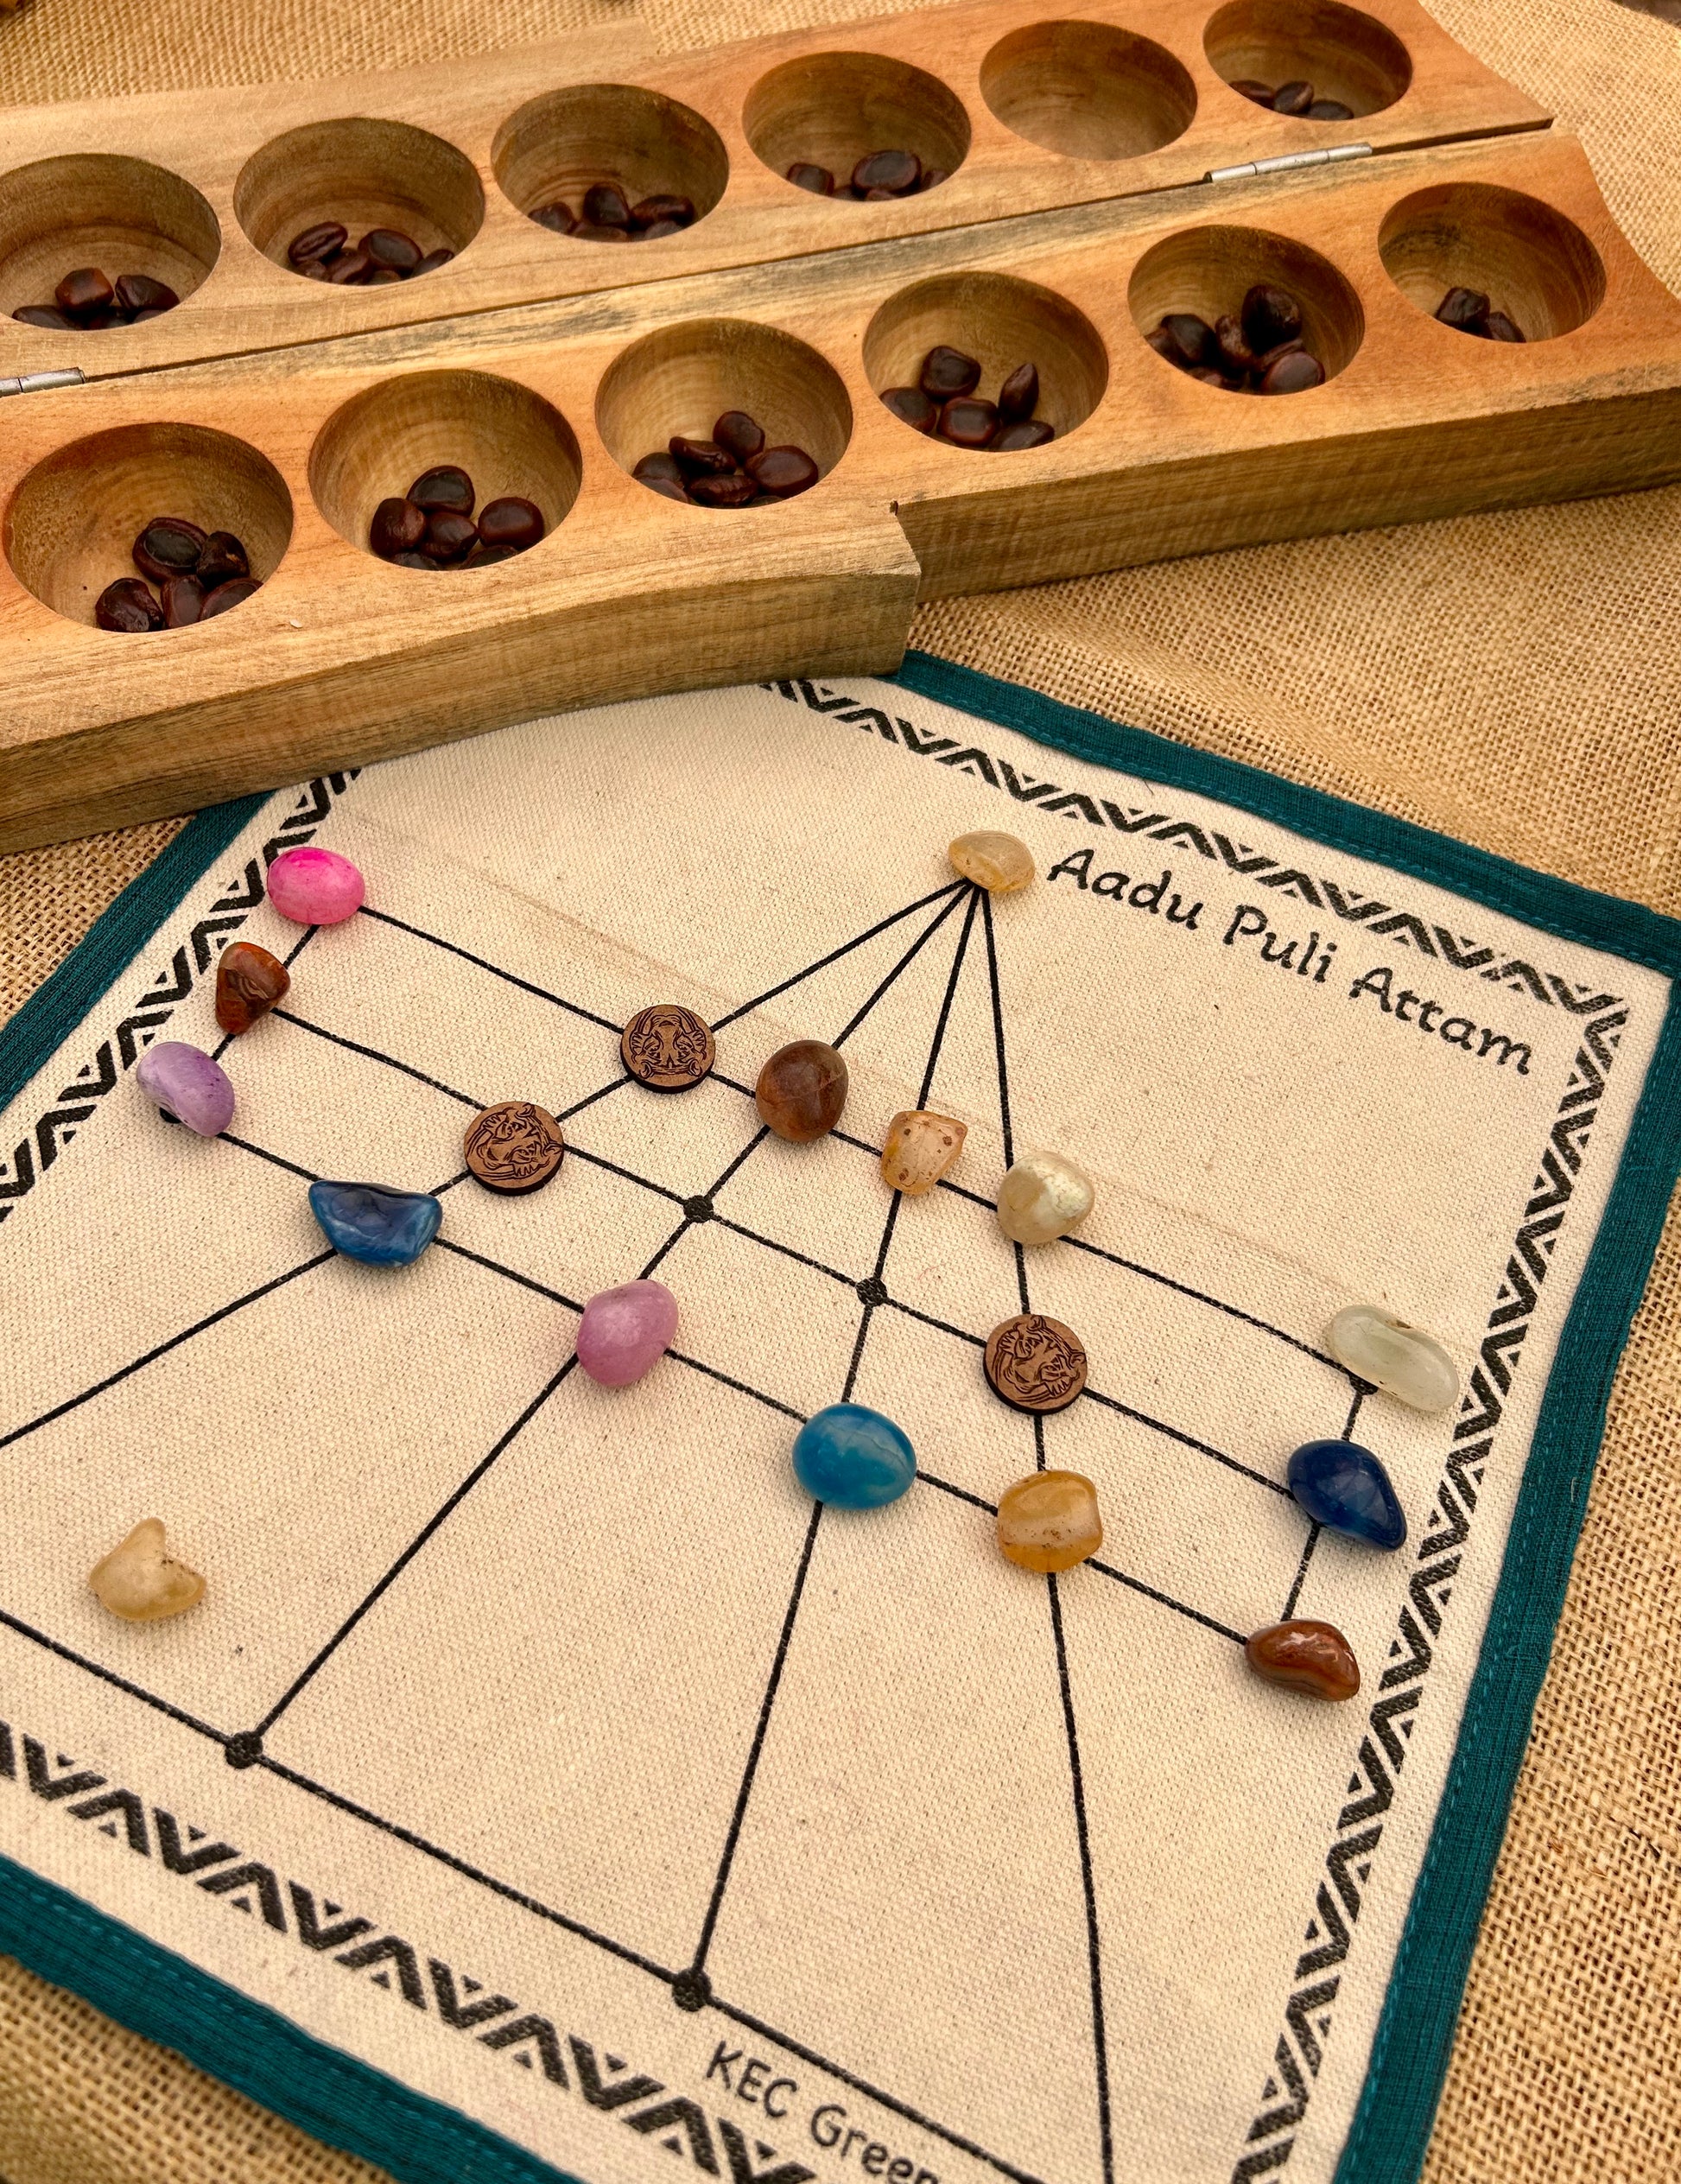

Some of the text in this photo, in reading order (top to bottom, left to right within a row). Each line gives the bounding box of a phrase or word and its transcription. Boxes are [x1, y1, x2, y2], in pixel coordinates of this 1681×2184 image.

[1046, 848, 1532, 1076] Aadu Puli Attam
[706, 2040, 798, 2117] KEC
